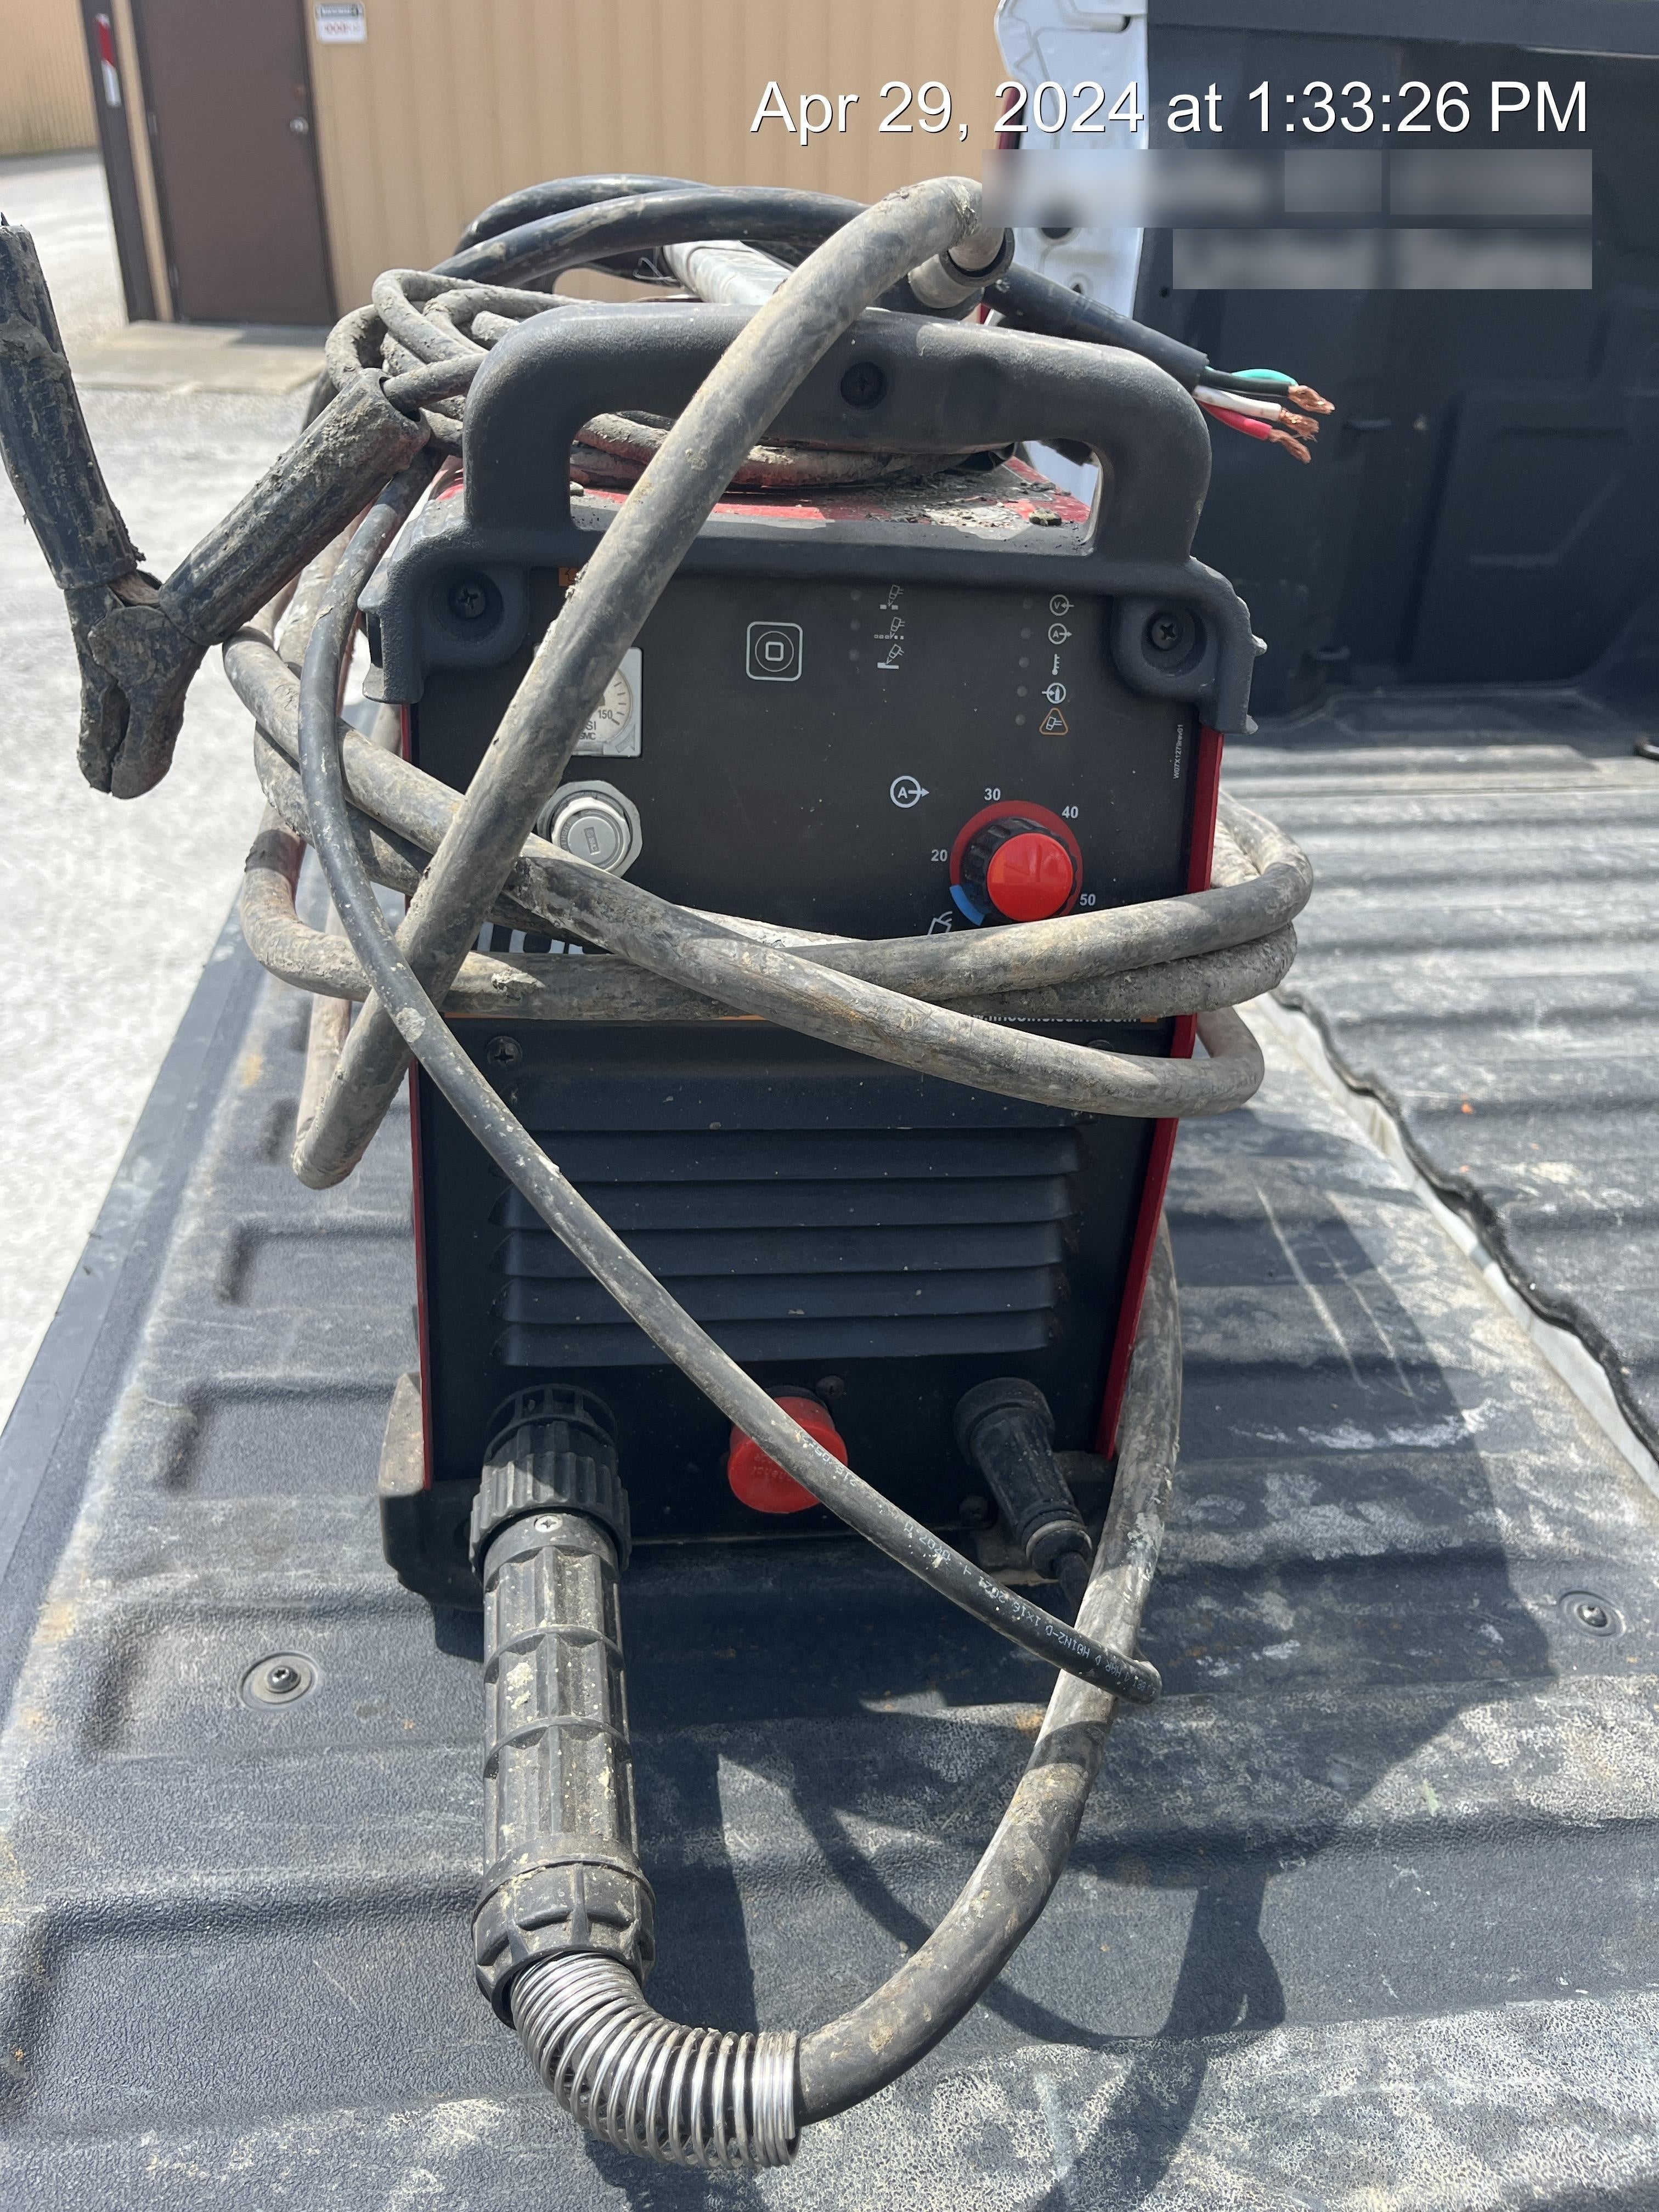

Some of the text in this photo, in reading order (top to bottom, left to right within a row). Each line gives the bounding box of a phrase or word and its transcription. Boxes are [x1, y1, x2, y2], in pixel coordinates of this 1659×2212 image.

[598, 710, 613, 719] 150
[585, 720, 596, 730] SI
[984, 788, 1001, 801] 30
[1062, 806, 1079, 819] 40
[930, 849, 947, 862] 20
[1080, 894, 1096, 906] 50
